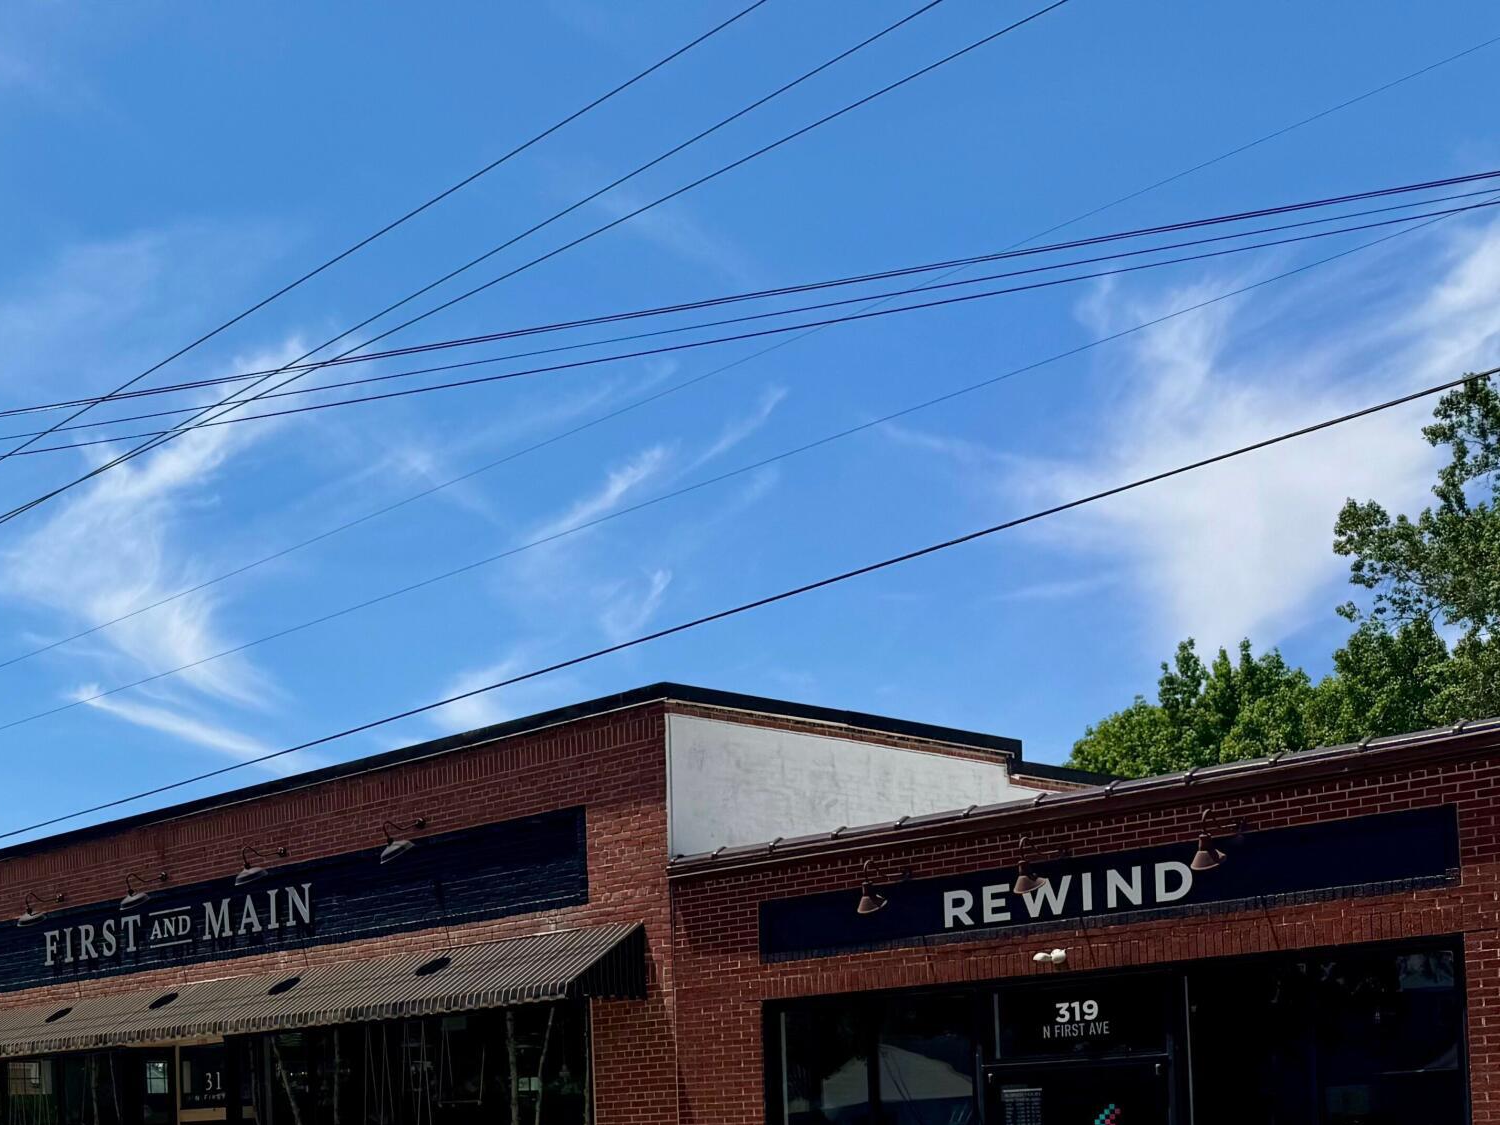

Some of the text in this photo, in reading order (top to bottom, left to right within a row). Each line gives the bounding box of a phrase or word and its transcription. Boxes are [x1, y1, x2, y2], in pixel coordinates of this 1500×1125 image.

[943, 861, 1193, 929] REWIND
[43, 883, 312, 967] FIRST AND MAIN
[1043, 1021, 1110, 1039] N FIRST AVE
[1055, 999, 1099, 1023] 319
